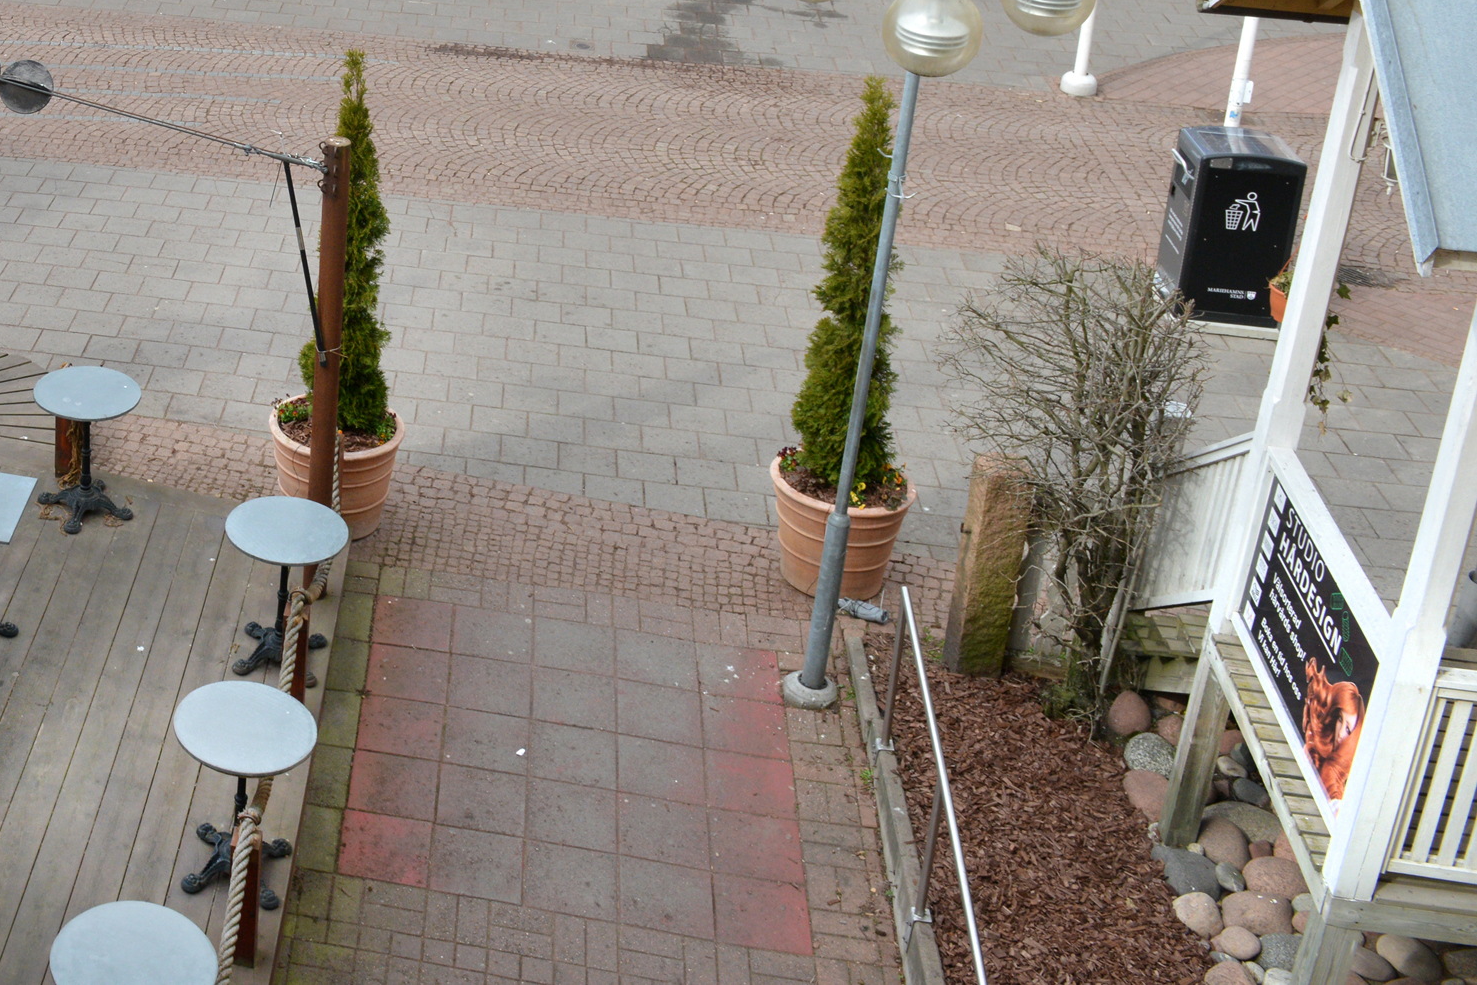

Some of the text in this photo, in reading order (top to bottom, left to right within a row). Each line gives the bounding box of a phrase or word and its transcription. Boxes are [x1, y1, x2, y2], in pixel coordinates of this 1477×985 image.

[1207, 287, 1244, 295] MARIEHAMNS
[1286, 507, 1325, 583] STUDIO
[1273, 572, 1302, 630] Välsorterad
[1279, 531, 1343, 656] HÅRDESIGN
[1257, 629, 1265, 644] Vi
[1261, 639, 1272, 659] kan
[1261, 617, 1302, 701] Boka en tid hos oss
[1290, 631, 1307, 662] shop!
